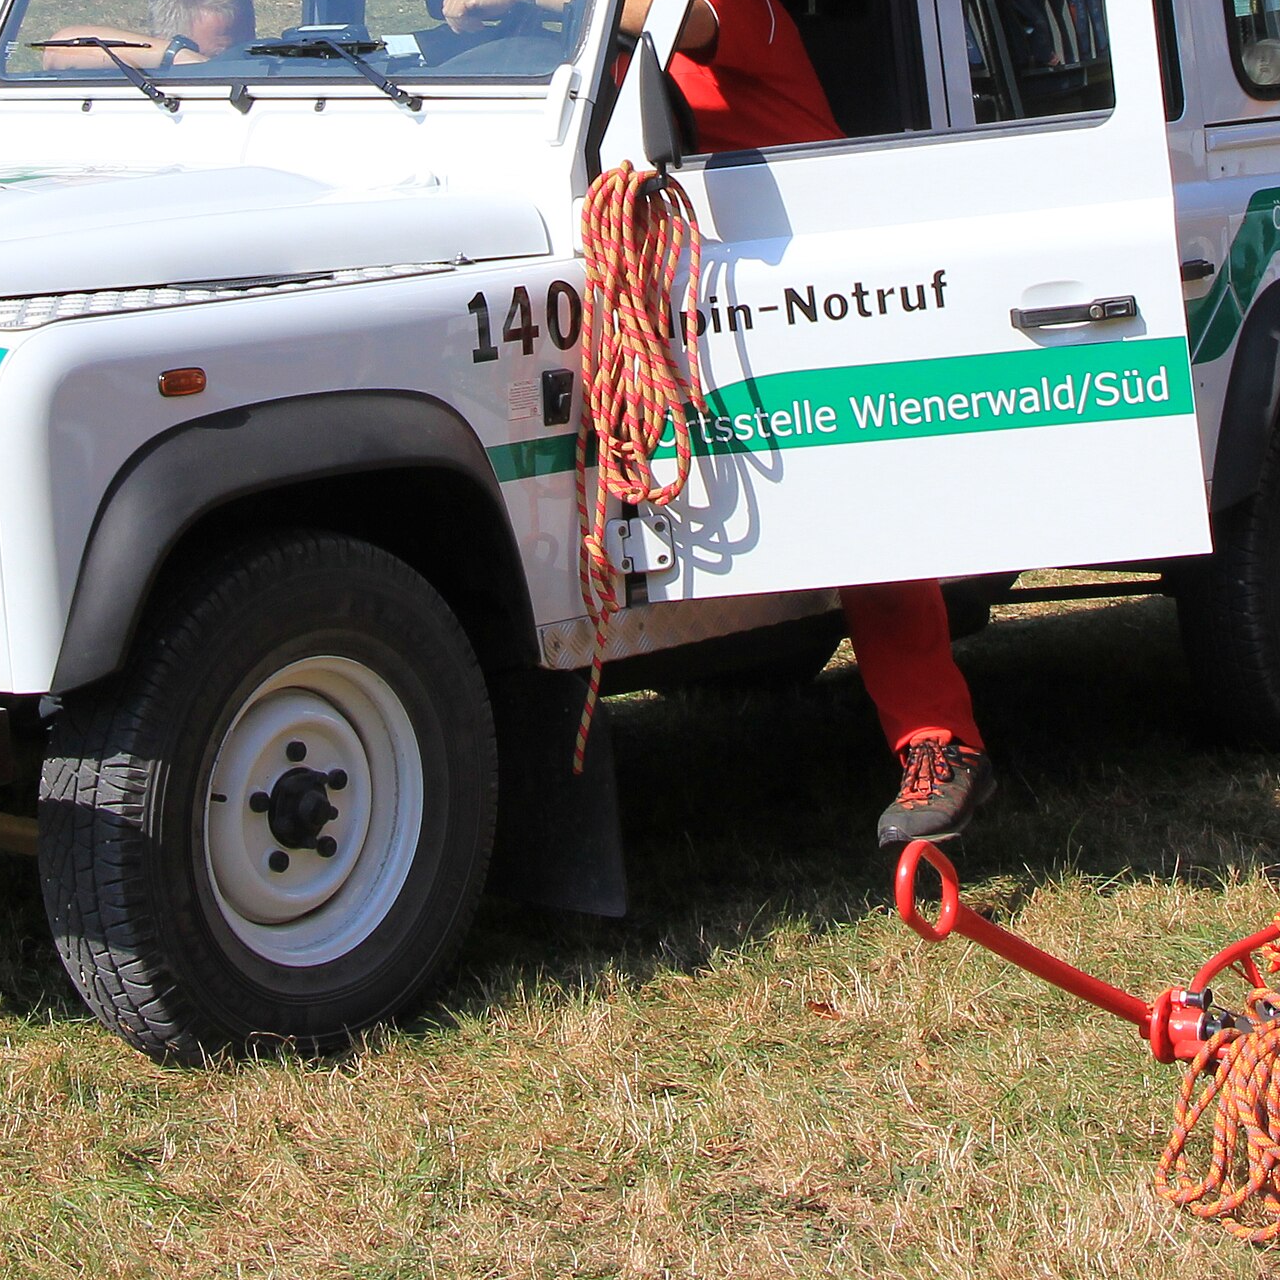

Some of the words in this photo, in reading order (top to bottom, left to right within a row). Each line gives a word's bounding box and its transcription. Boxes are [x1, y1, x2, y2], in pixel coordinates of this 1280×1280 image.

[467, 280, 582, 364] 140
[666, 269, 948, 347] lpin-Notruf
[848, 366, 1169, 431] Wienerwald/Süd
